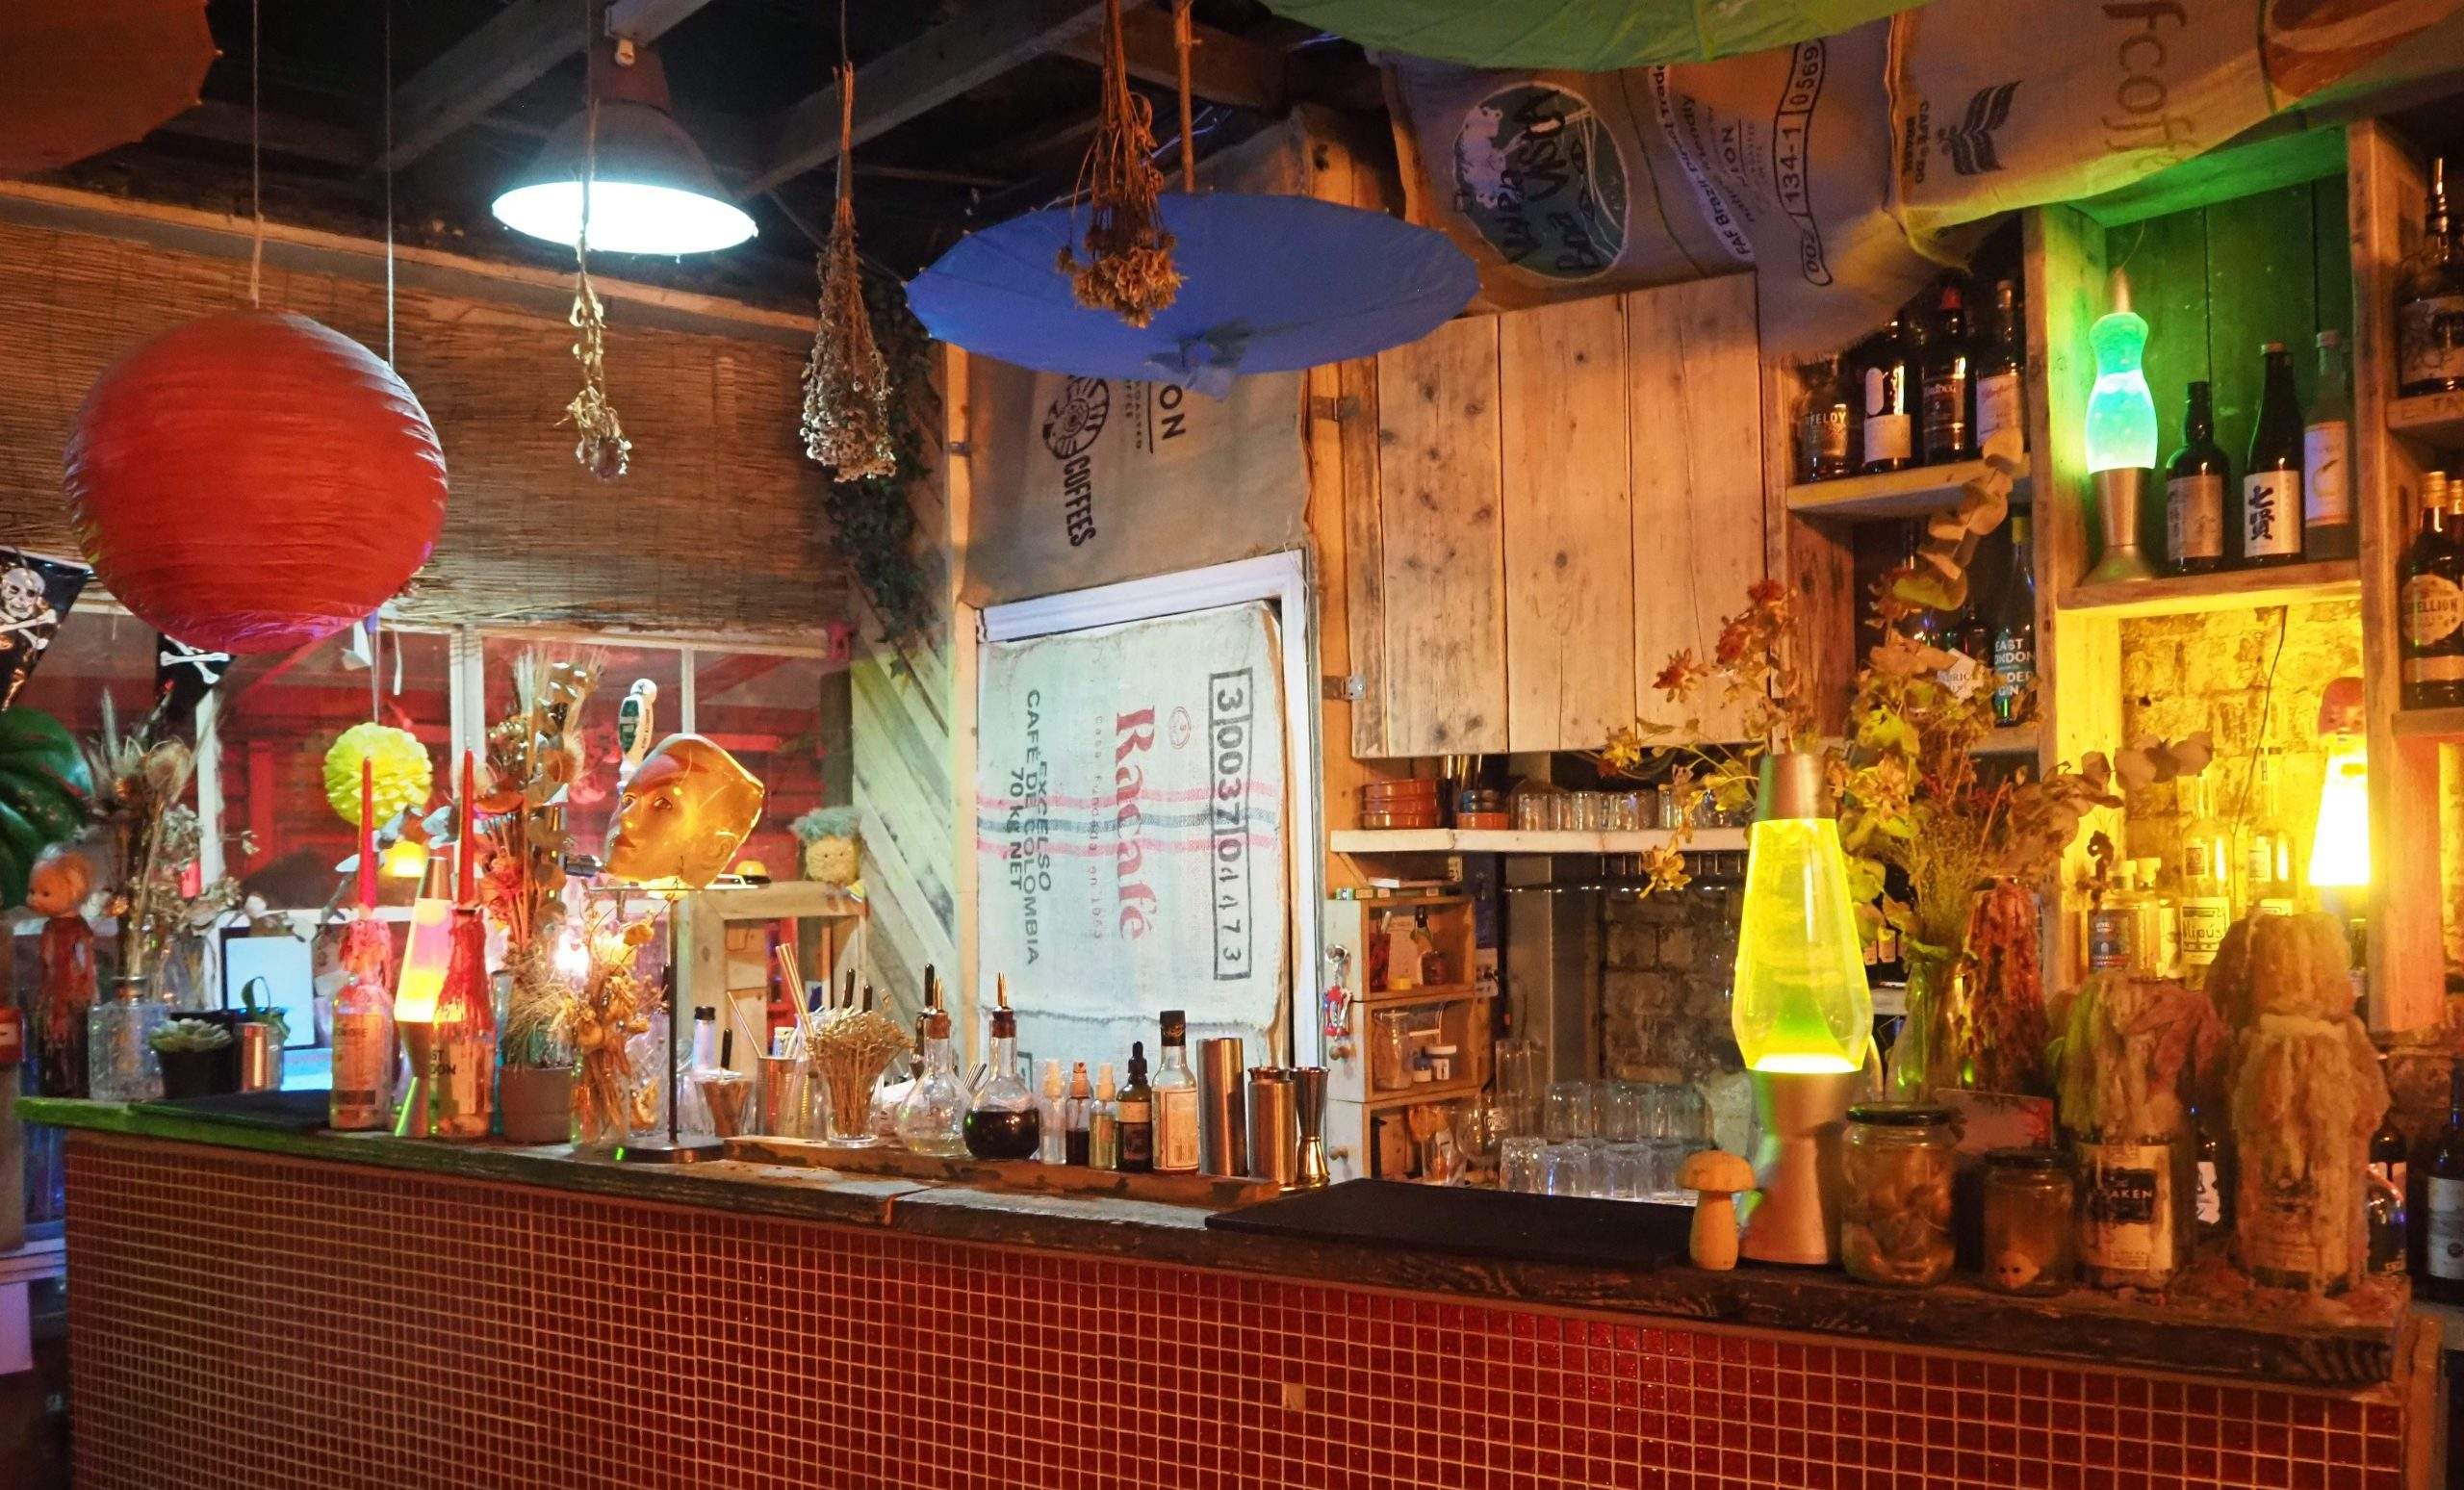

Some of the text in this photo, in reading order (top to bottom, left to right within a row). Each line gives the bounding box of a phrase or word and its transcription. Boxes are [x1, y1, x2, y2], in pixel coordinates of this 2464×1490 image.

[1781, 125, 1803, 203] 134-1
[1697, 180, 1732, 227] Brazil
[1724, 230, 1750, 256] FAF
[1064, 454, 1096, 547] COFFEES
[1994, 638, 2024, 652] EAST
[1010, 767, 1024, 798] 70
[1025, 772, 1038, 809] DE
[1038, 760, 1051, 891] EXCELSO
[1115, 705, 1158, 940] Racafé
[1217, 686, 1245, 963] 3 0037 04473
[1011, 841, 1022, 890] NET
[1023, 818, 1040, 964] COLOMBIA
[2110, 1189, 2153, 1199] AKEN
